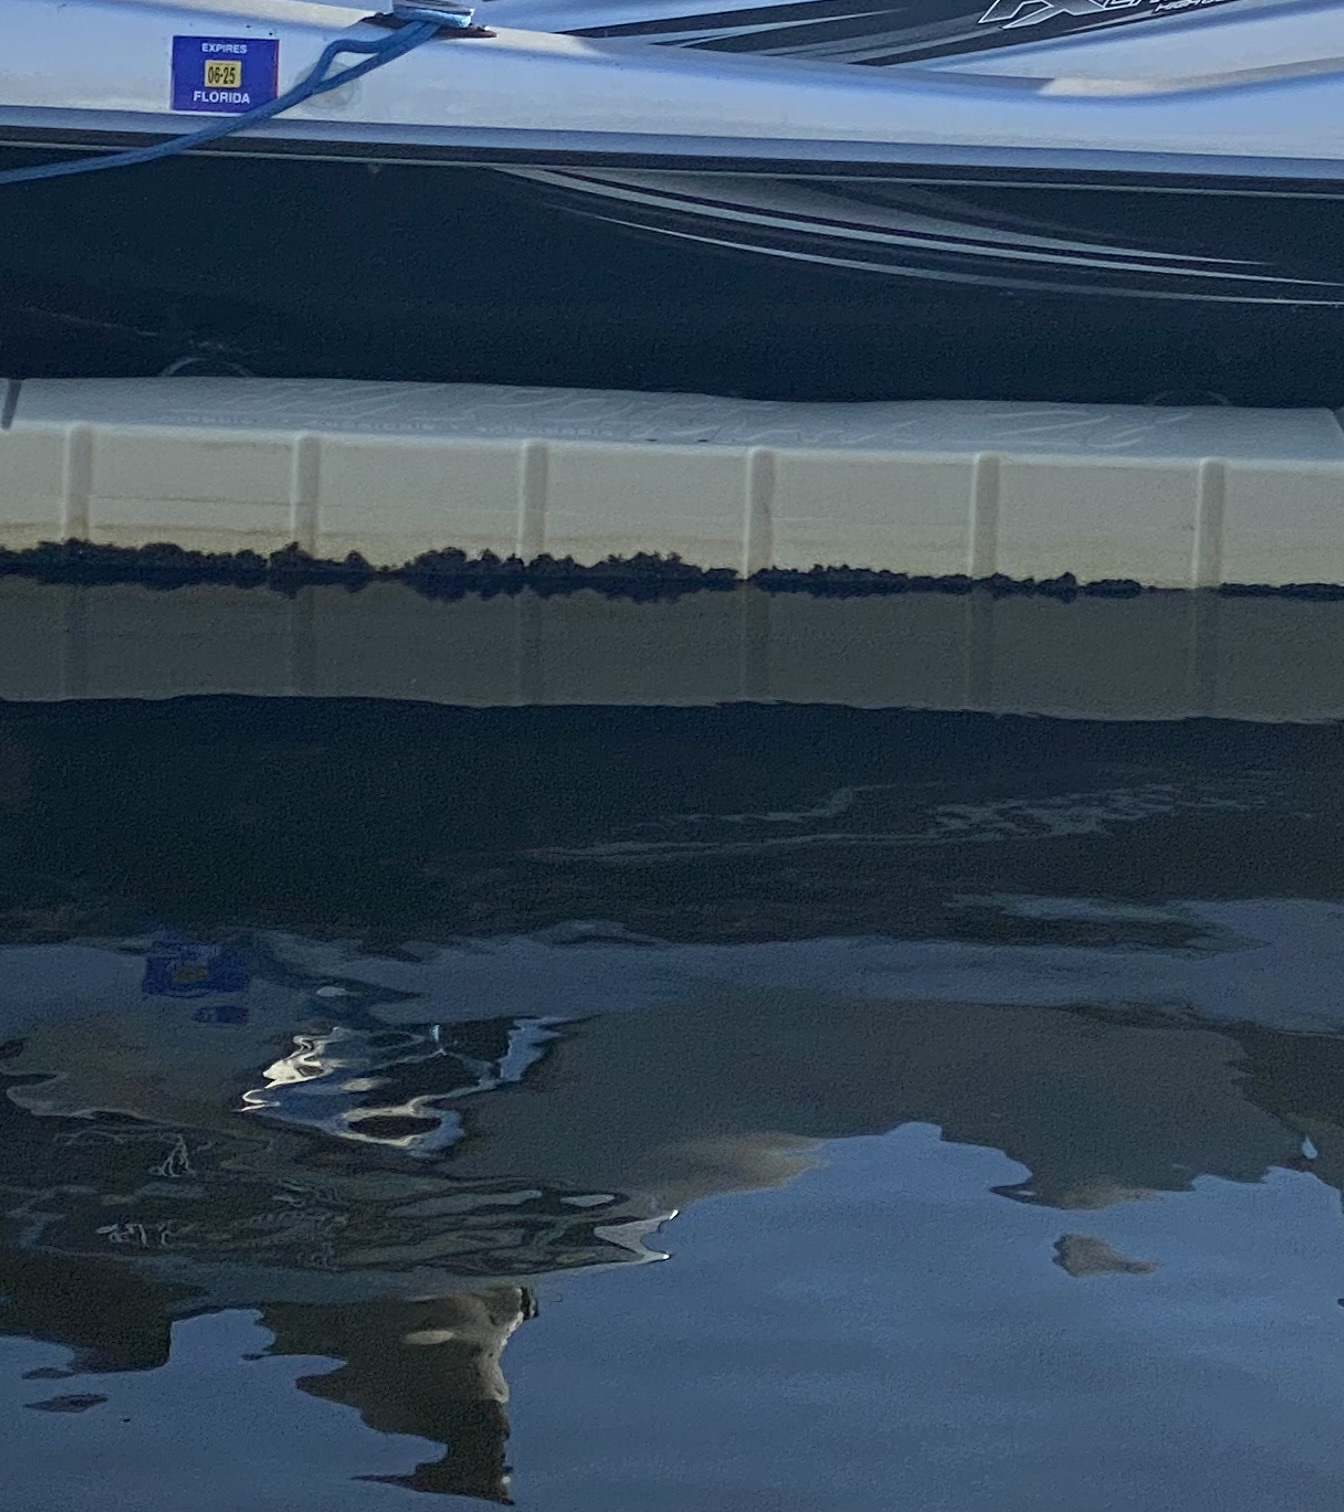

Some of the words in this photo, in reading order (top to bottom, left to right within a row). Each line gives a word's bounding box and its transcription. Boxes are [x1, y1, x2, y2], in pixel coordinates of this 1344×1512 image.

[201, 43, 248, 54] EXPIRES
[207, 66, 236, 85] 06-25
[193, 91, 251, 104] FLORIDA
